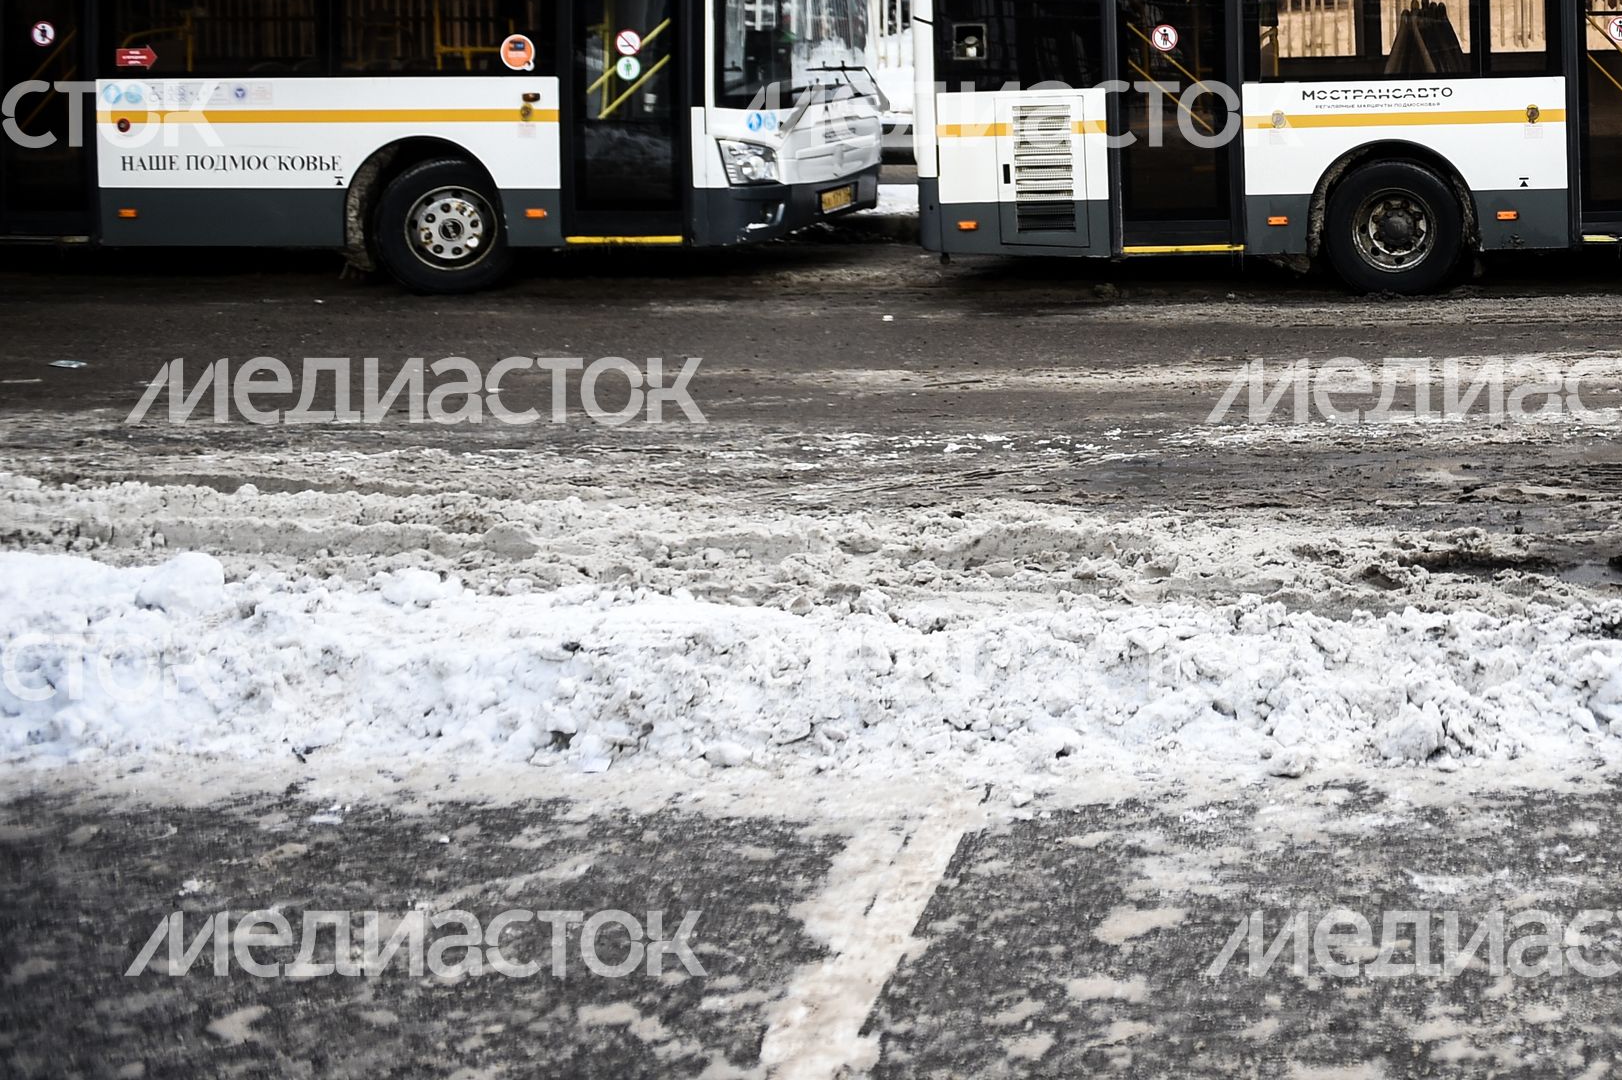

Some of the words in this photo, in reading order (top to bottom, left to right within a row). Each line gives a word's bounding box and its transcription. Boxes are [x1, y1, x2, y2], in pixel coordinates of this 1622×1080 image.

[1302, 87, 1453, 101] МОСТРАНСАВТО
[121, 155, 179, 171] НАШЕ
[185, 155, 343, 172] ПОДМОСКОВЬЕ
